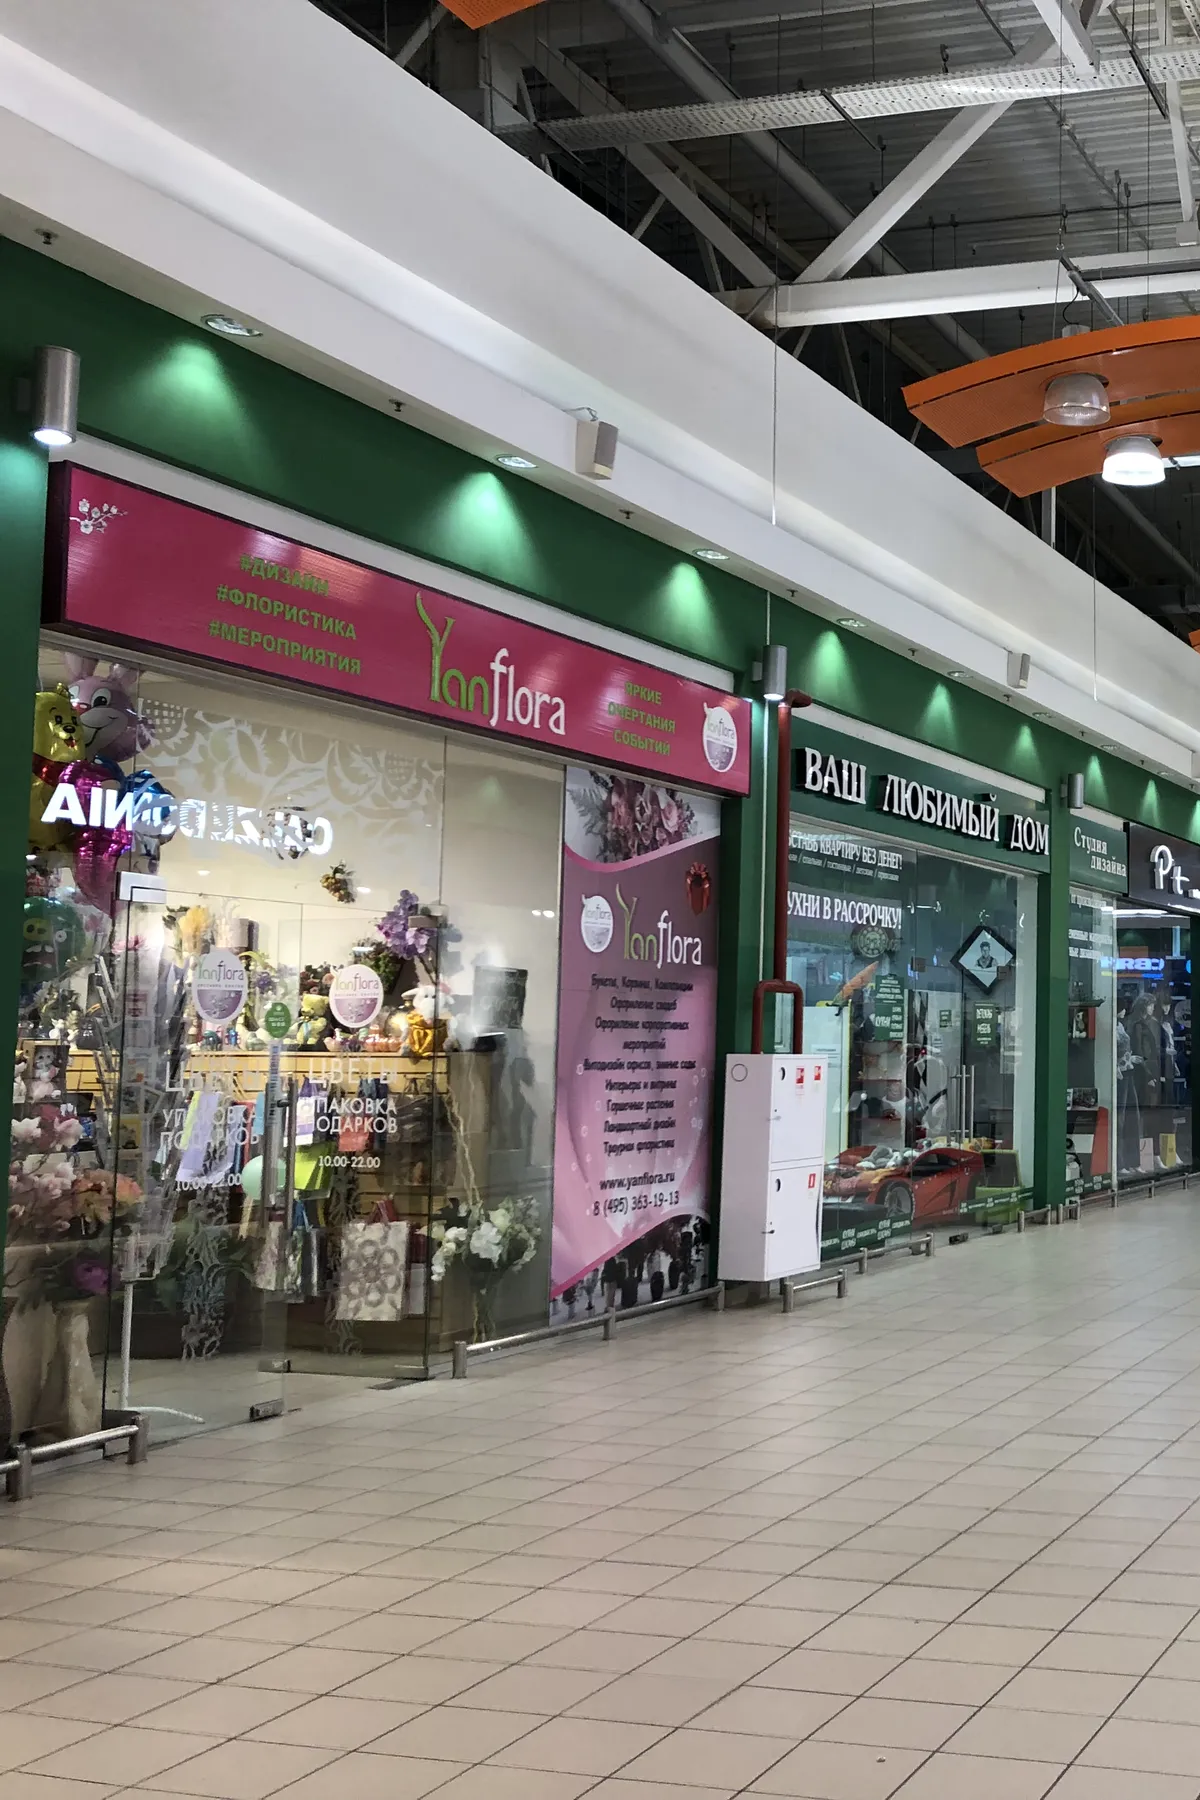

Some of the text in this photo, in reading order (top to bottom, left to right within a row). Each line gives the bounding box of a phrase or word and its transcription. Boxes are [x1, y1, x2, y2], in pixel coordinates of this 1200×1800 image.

[240, 554, 330, 597] #ДИЗАЙН
[216, 584, 357, 640] #ФЛОРИСТИКА
[209, 620, 362, 676] #МЕРОПРИЯТИЯ
[415, 590, 566, 735] Yanflora
[624, 681, 662, 706] ЯРКИЕ
[607, 701, 676, 734] ОЧЕРТАНИЯ
[614, 728, 671, 757] СОБЫТИЙ
[804, 747, 1050, 856] ВАШ ЛЮБИМЫЙ ДОМ
[1074, 826, 1108, 855] Студия
[862, 846, 877, 865] БЕЗ
[877, 849, 902, 870] ДЕНЕГ!
[1090, 855, 1127, 877] дизайна
[787, 890, 902, 930] УХНИ В РАССРОЧКУ!
[616, 883, 702, 969] Yanflora
[309, 1057, 398, 1089] ЦВЕТЫ
[316, 1097, 398, 1115] ПАКОВКА
[317, 1115, 398, 1134] ОДАРКОВ
[319, 1155, 381, 1169] 10.00-22.00
[593, 1190, 680, 1216] 8 (495) 363-19-13
